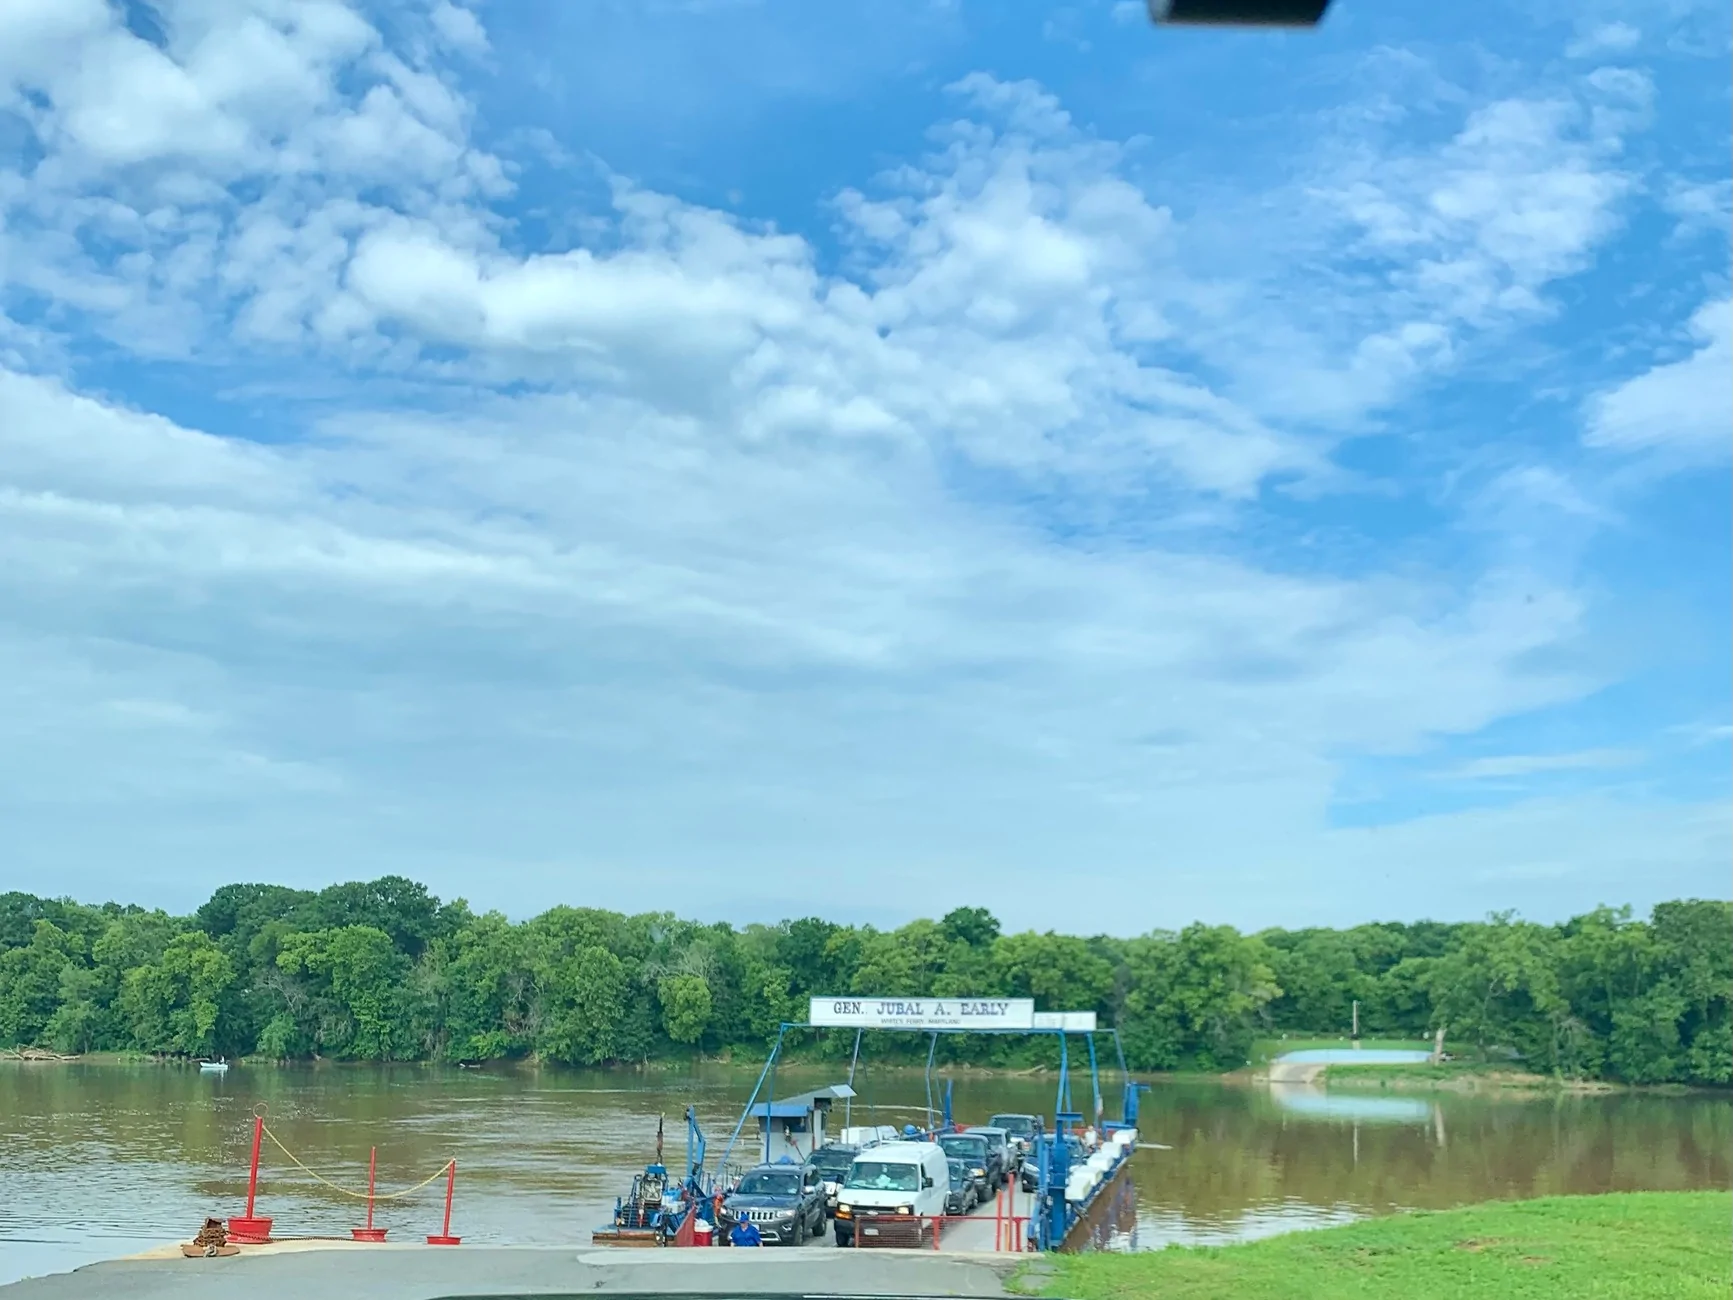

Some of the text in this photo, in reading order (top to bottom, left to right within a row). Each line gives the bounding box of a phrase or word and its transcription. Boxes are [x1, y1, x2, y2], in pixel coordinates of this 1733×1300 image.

[833, 1001, 1009, 1016] GEN. JUBAL A. EARLY
